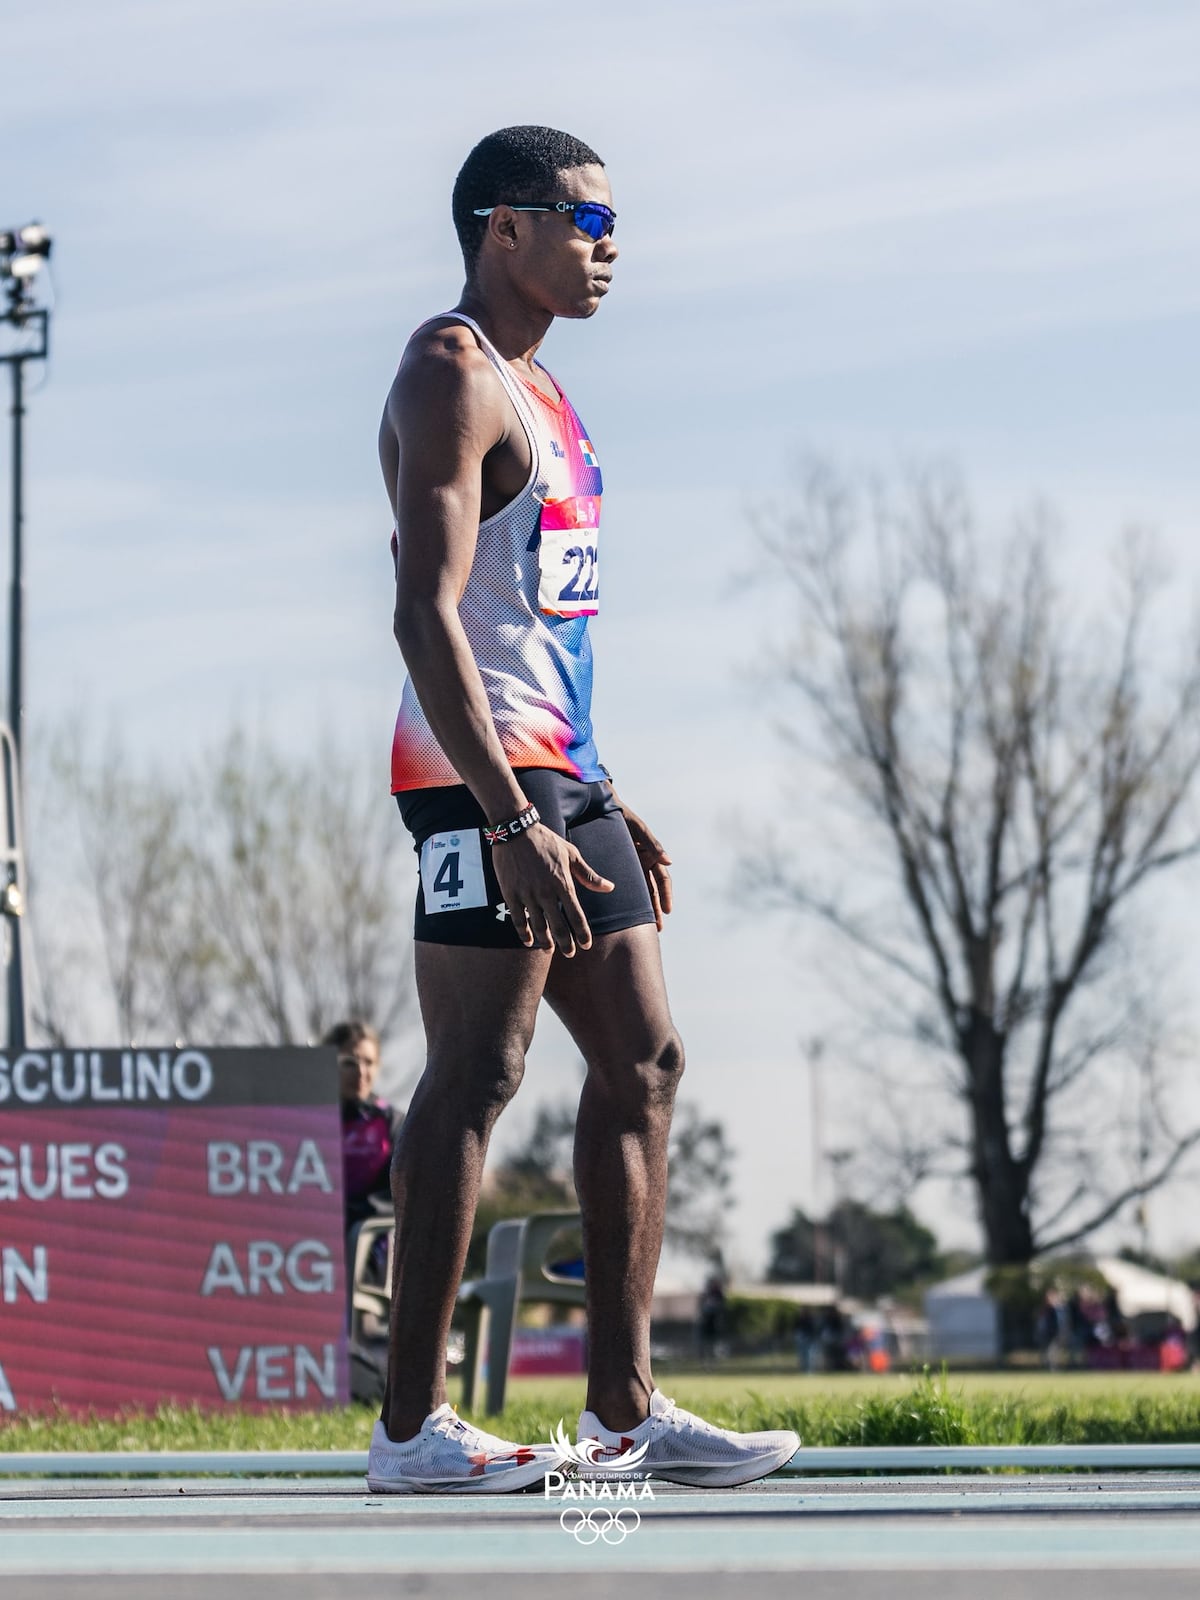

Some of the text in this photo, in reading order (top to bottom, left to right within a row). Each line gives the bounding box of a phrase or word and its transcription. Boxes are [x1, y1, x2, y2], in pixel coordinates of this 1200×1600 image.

[433, 851, 464, 898] 4
[207, 1139, 333, 1196] BRA
[202, 1240, 335, 1297] ARG
[207, 1343, 337, 1402] VEN
